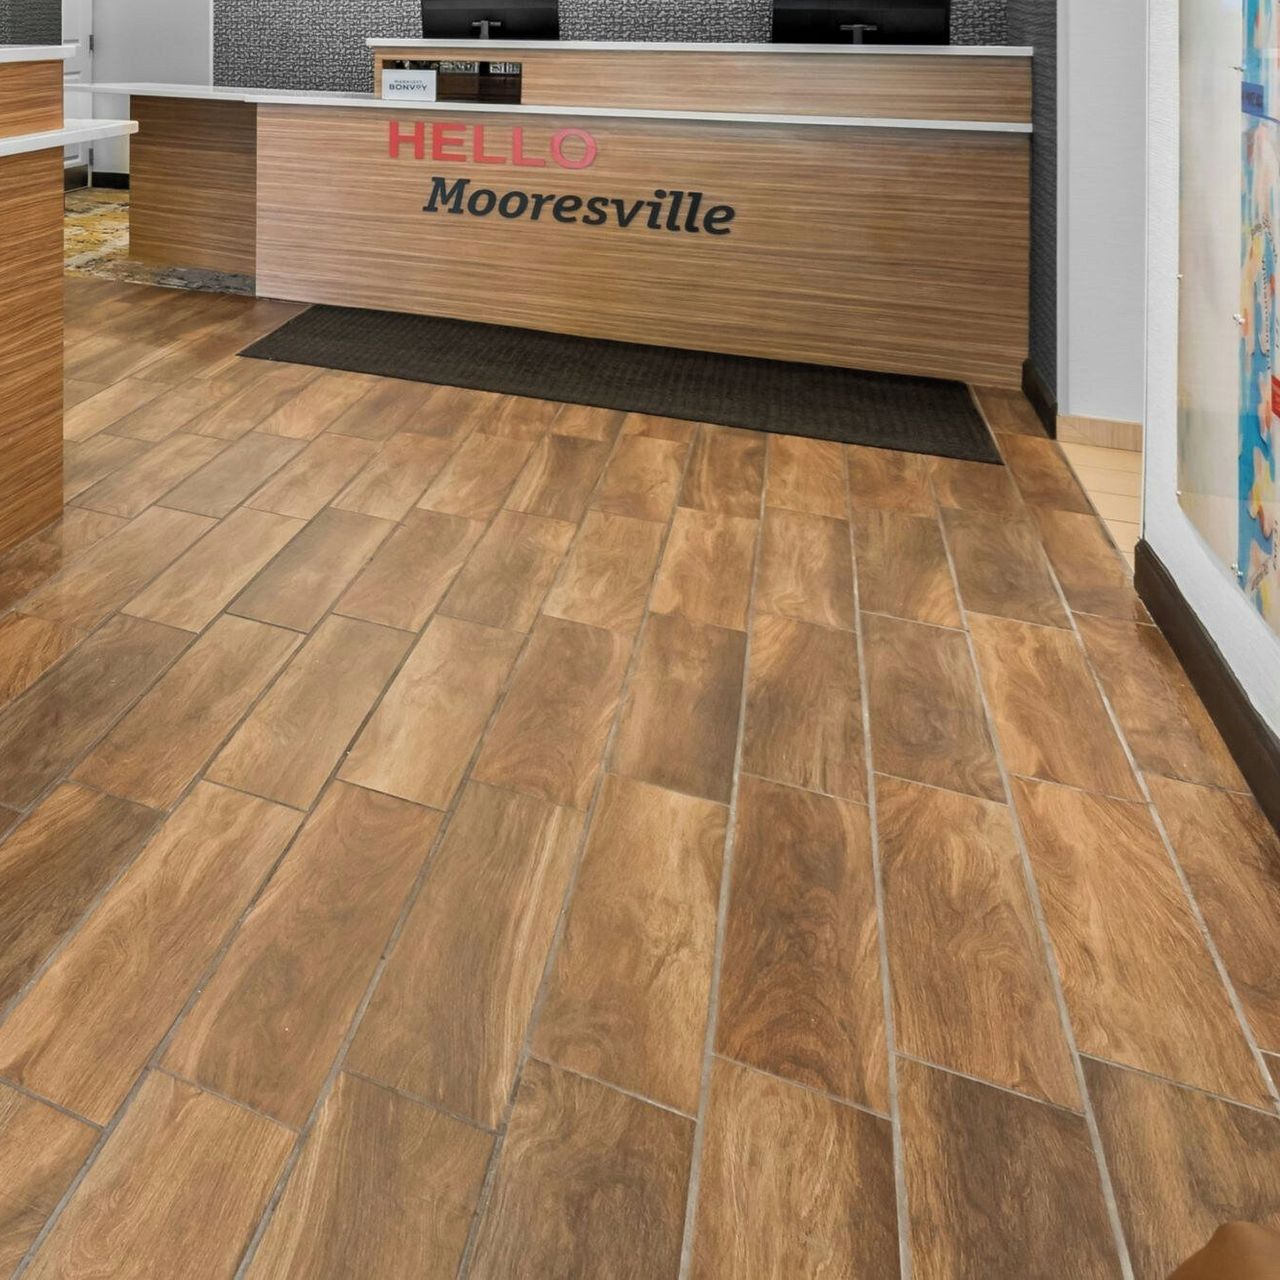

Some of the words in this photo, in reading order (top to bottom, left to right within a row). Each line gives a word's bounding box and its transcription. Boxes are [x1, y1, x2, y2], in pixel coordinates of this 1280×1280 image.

[389, 83, 427, 91] BONVOY
[390, 120, 598, 170] HELLO
[422, 176, 736, 236] Mooresville
